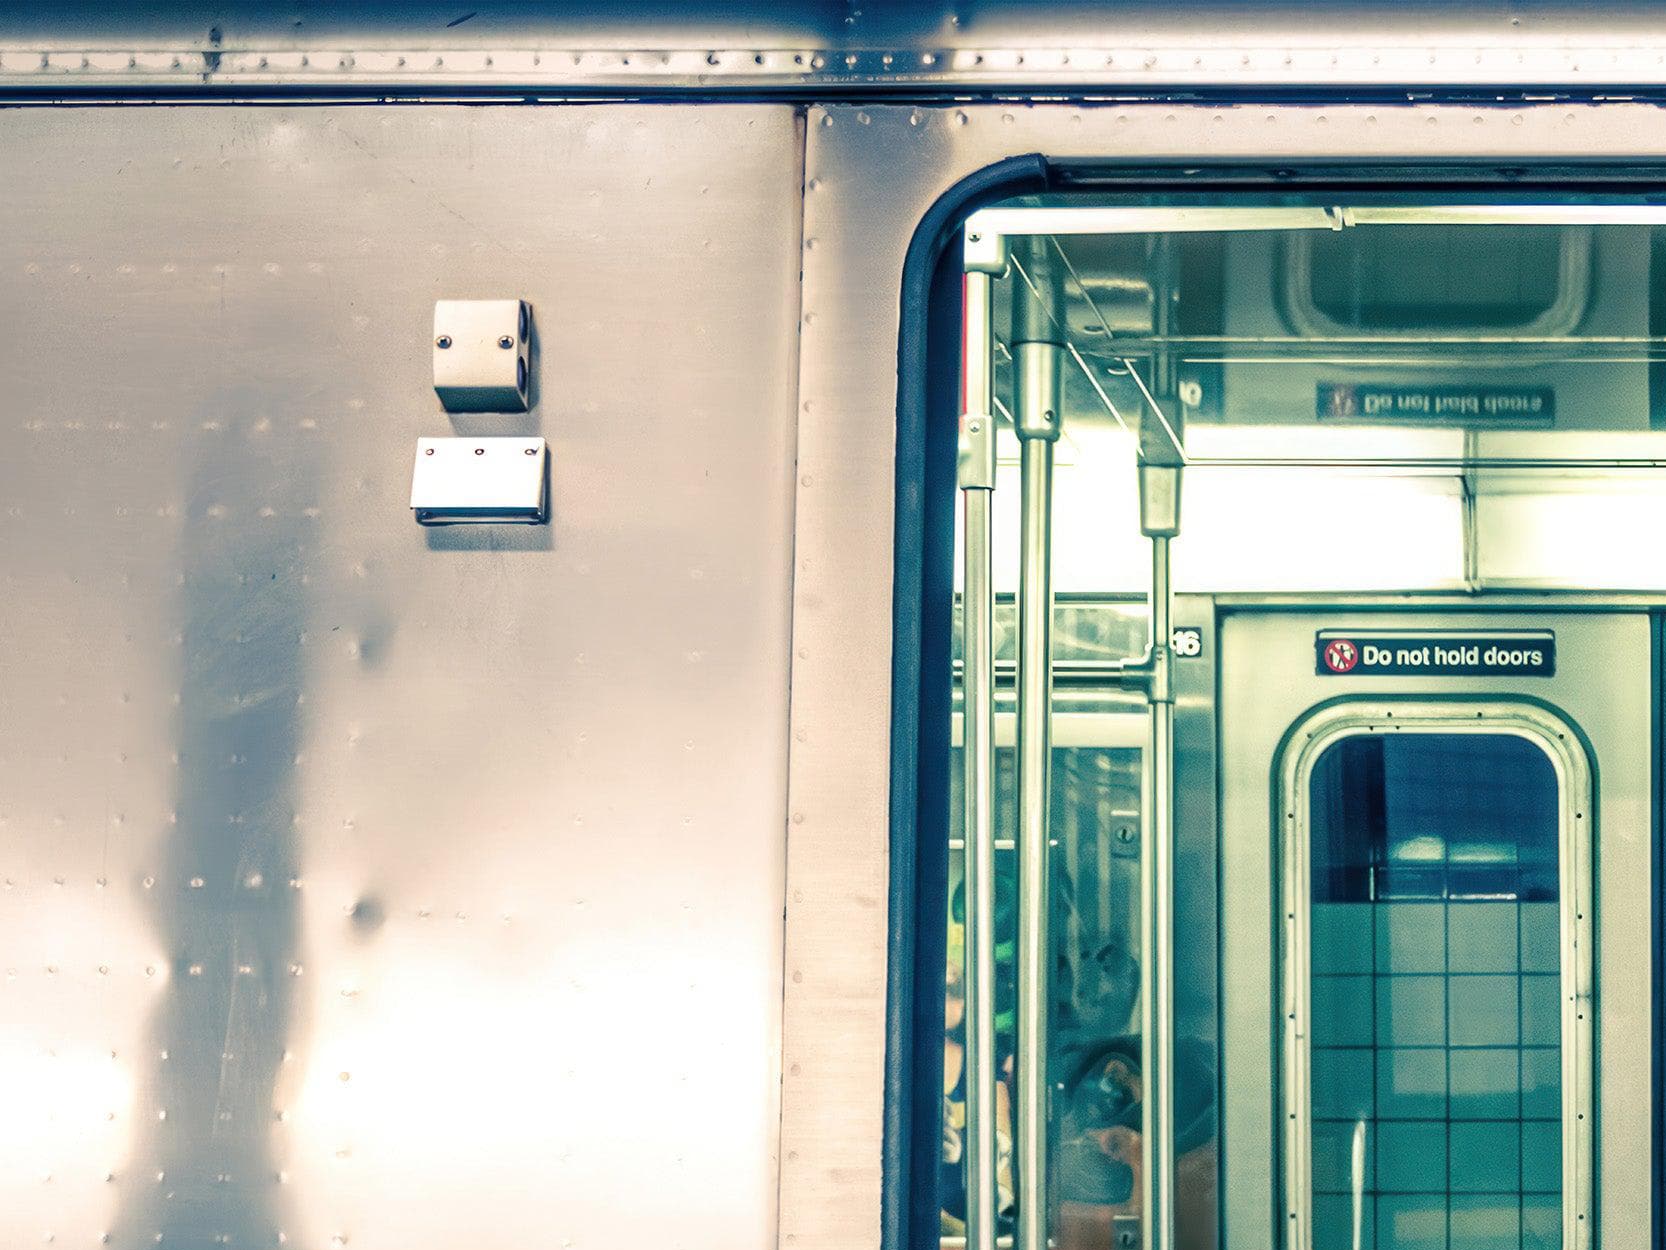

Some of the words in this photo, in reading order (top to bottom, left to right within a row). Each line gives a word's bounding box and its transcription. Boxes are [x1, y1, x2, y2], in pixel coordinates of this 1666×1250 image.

[1172, 630, 1201, 656] 16
[1362, 646, 1392, 666] Do
[1396, 647, 1430, 666] not
[1434, 645, 1480, 666] hold
[1485, 645, 1544, 666] doors
